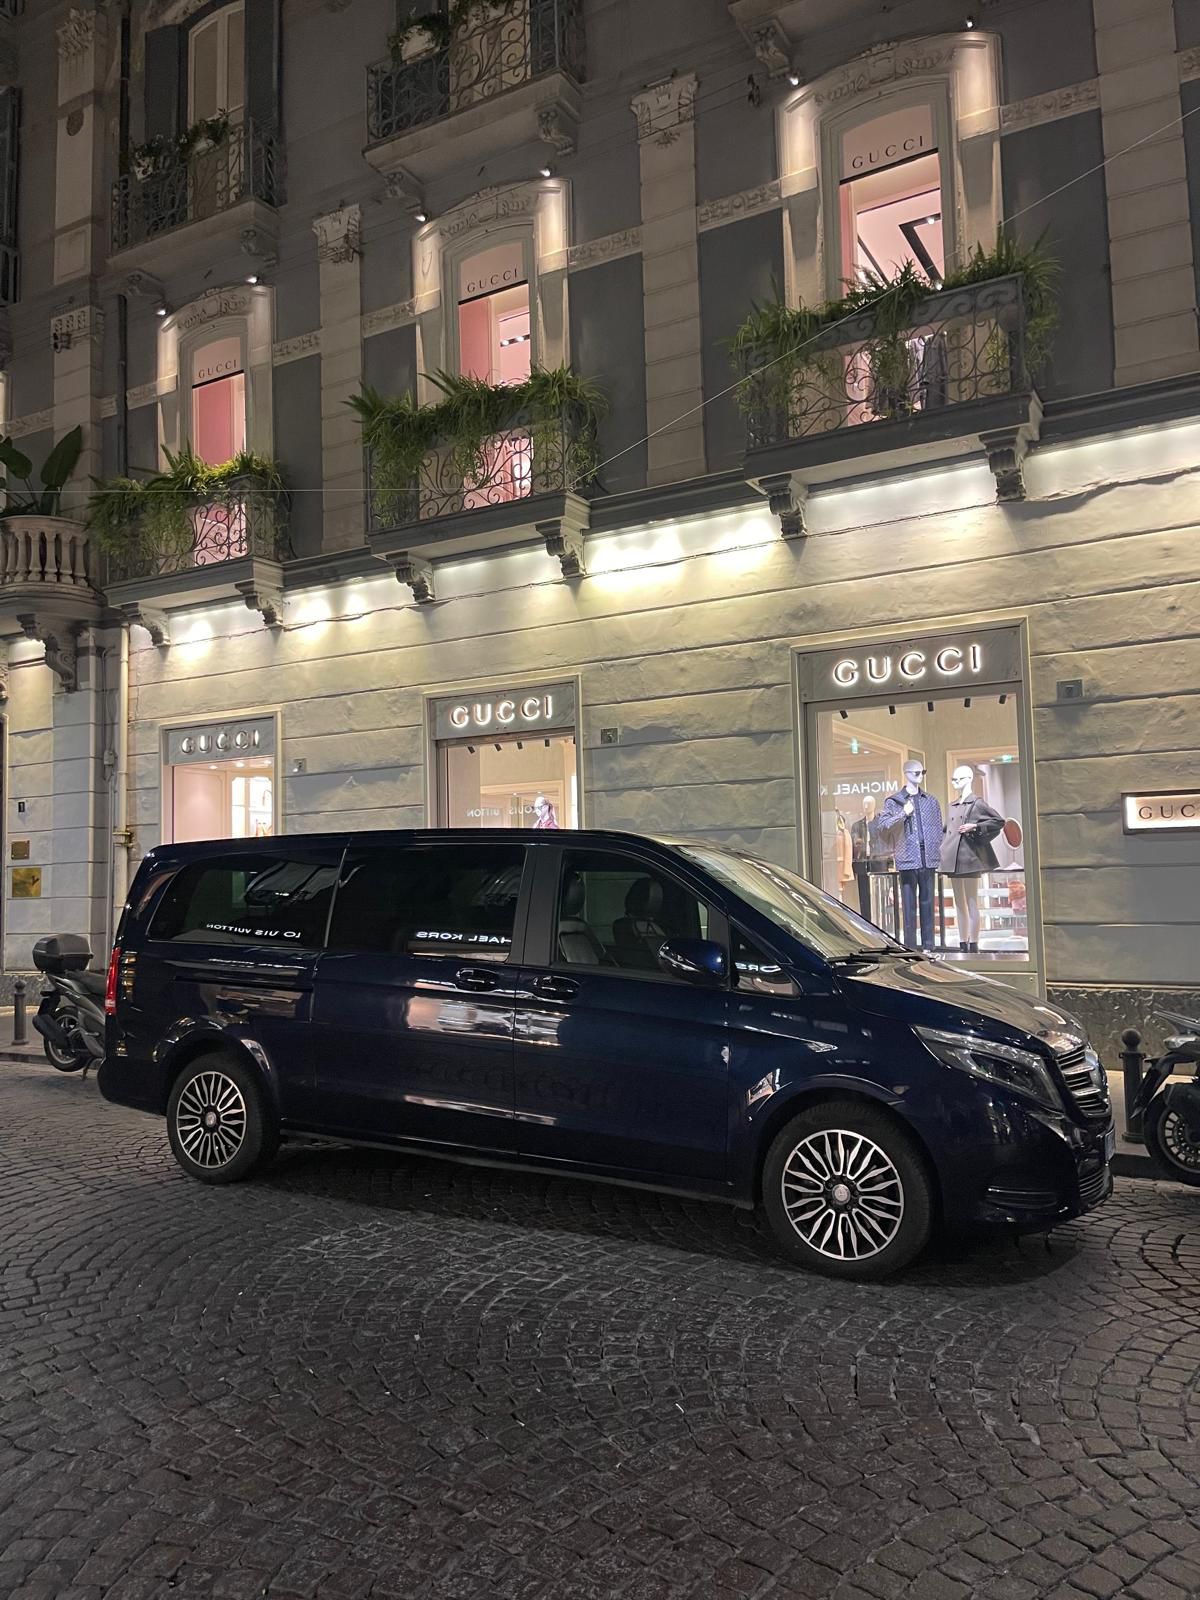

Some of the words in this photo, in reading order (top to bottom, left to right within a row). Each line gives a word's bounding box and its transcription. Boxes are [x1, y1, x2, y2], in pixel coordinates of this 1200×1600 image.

[852, 135, 923, 169] GUCCI
[467, 268, 518, 293] GUCCI
[198, 359, 237, 379] GUCCI
[832, 643, 981, 687] GUCCI
[449, 694, 552, 728] GUCCI
[180, 729, 260, 755] GUCCI
[1138, 804, 1196, 820] GUC
